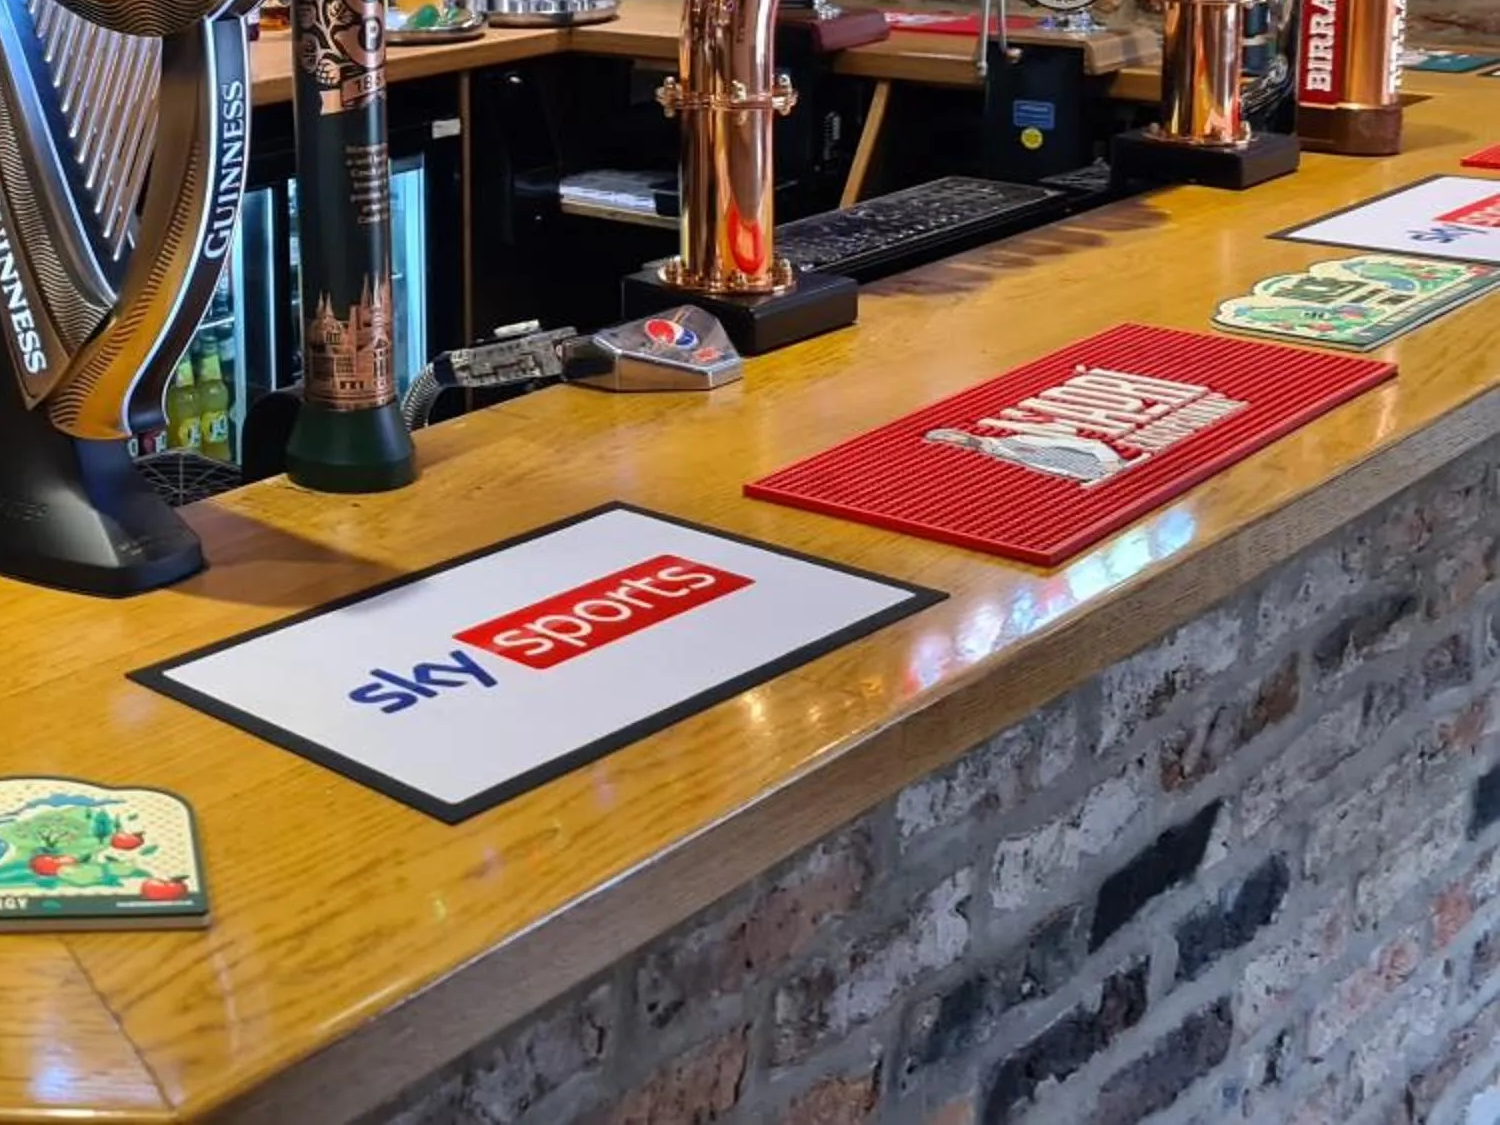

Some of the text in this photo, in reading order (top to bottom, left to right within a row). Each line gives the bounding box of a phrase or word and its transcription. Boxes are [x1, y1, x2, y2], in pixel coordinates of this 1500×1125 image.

[204, 79, 244, 261] GUINNESS
[349, 563, 716, 715] sky sports
